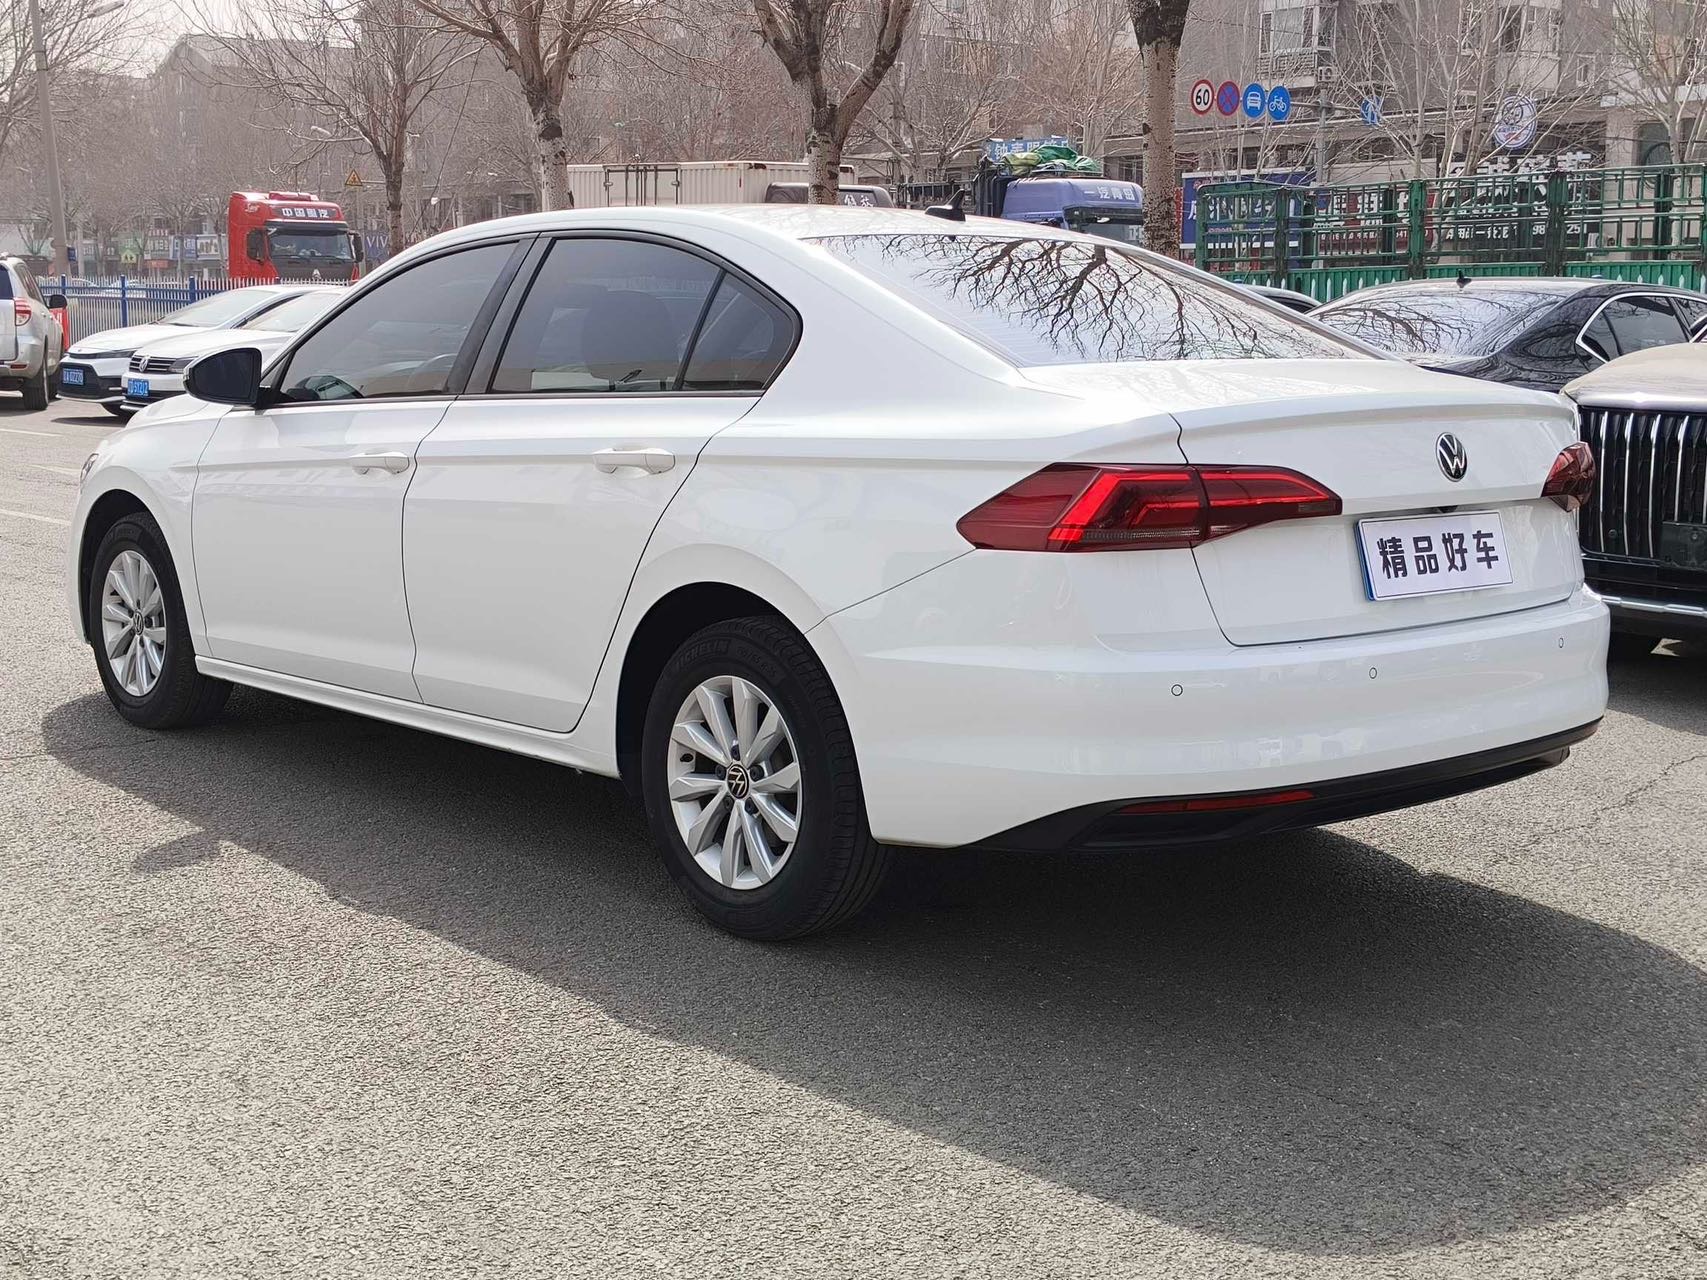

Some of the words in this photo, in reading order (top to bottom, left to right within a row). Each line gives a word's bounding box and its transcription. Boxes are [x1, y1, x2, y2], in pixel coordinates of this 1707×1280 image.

[1195, 88, 1211, 106] 60
[1377, 530, 1500, 580] 精品好车
